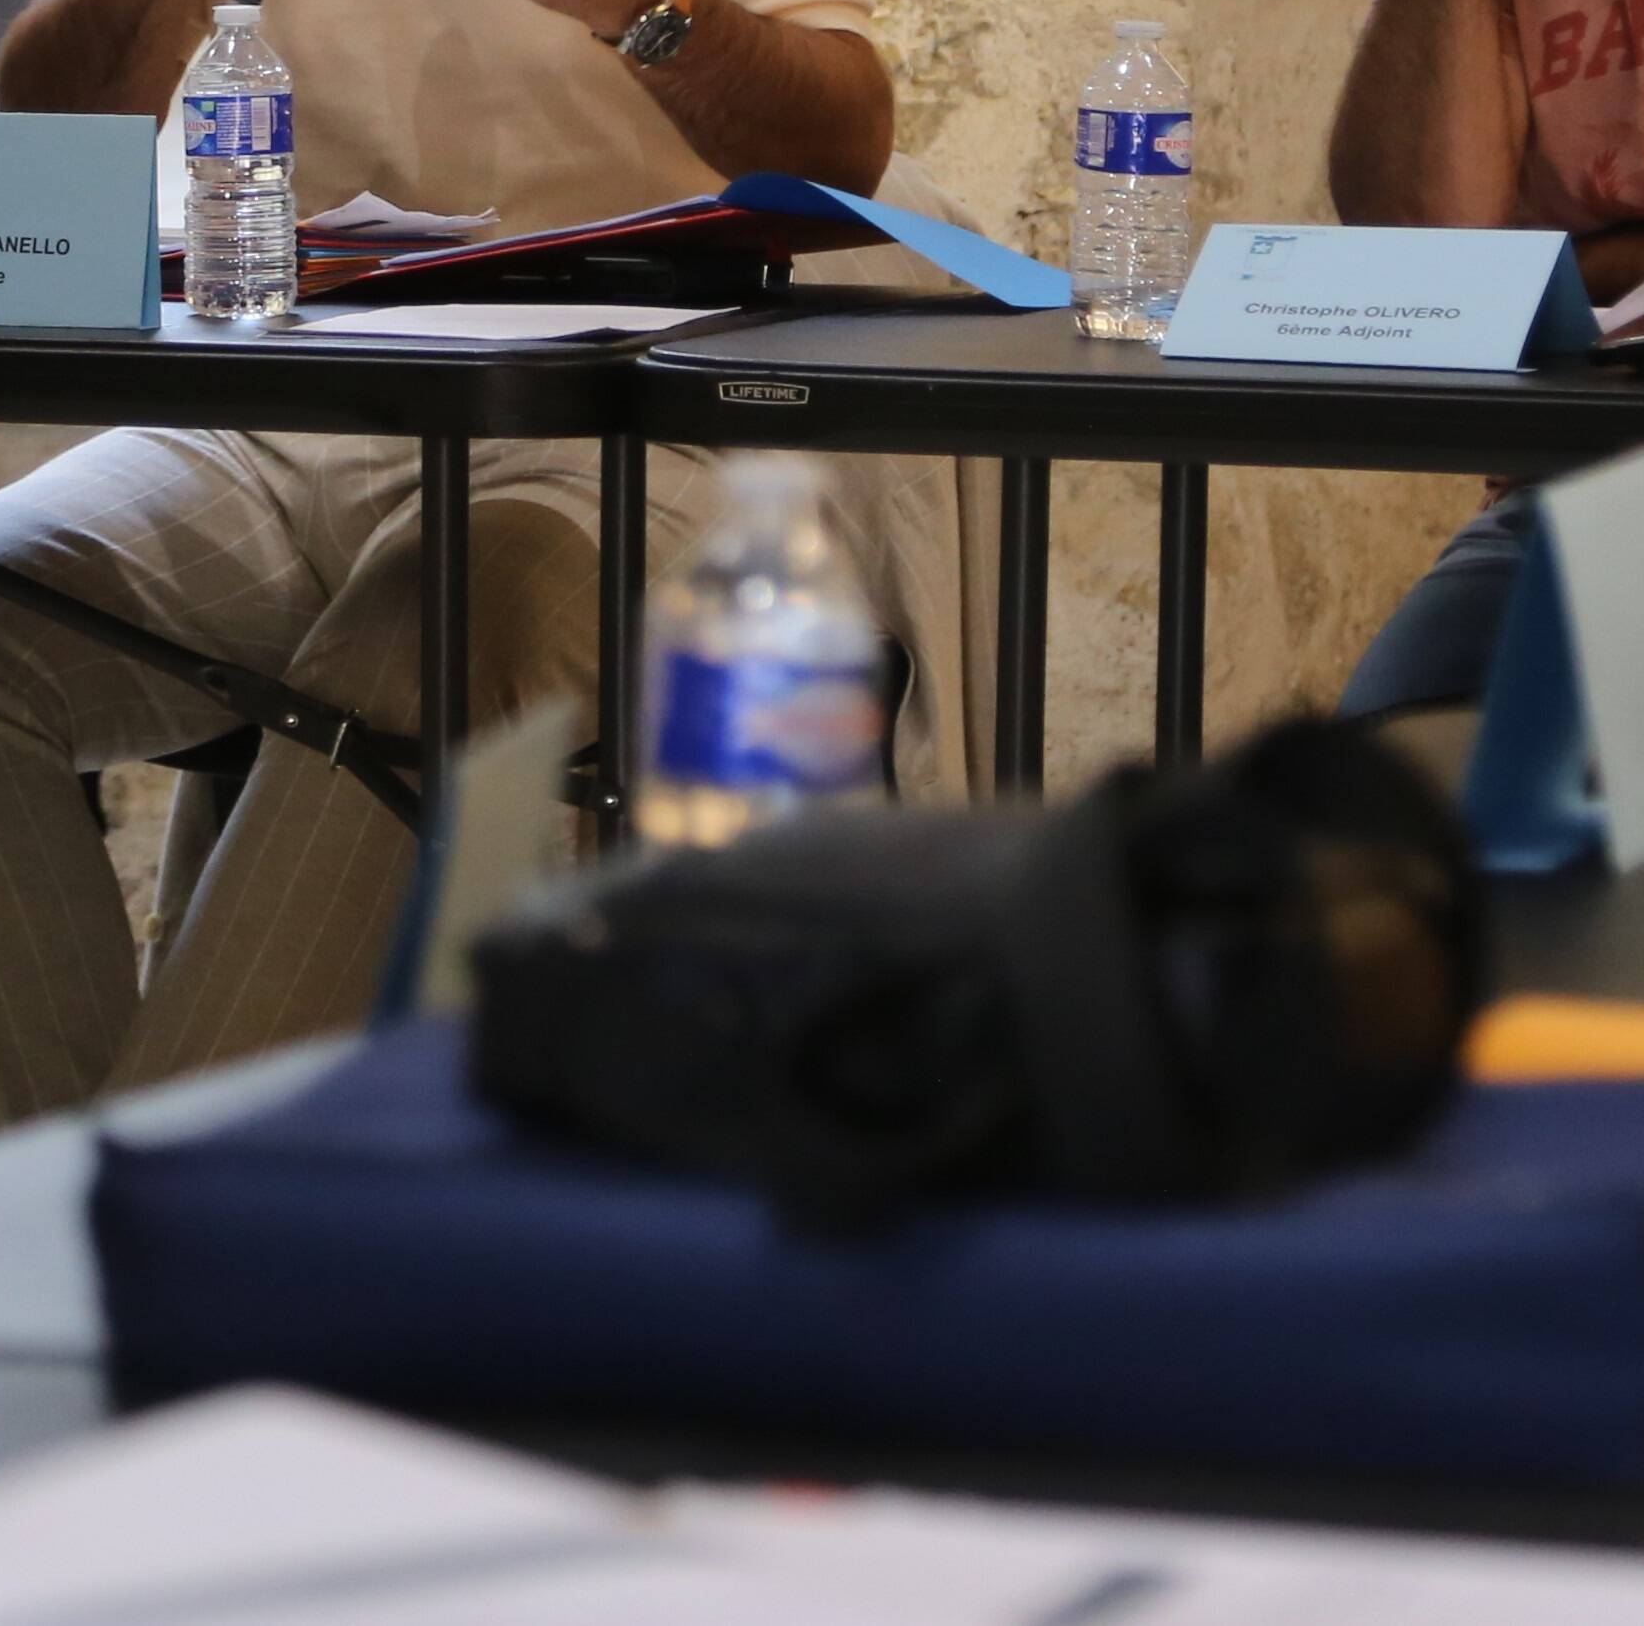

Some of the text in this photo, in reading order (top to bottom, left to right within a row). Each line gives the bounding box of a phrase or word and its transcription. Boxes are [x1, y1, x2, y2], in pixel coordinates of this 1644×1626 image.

[1244, 302, 1461, 320] Christophe OLIVERO
[1337, 325, 1413, 341] Adjoint
[729, 385, 798, 400] LIFETIME
